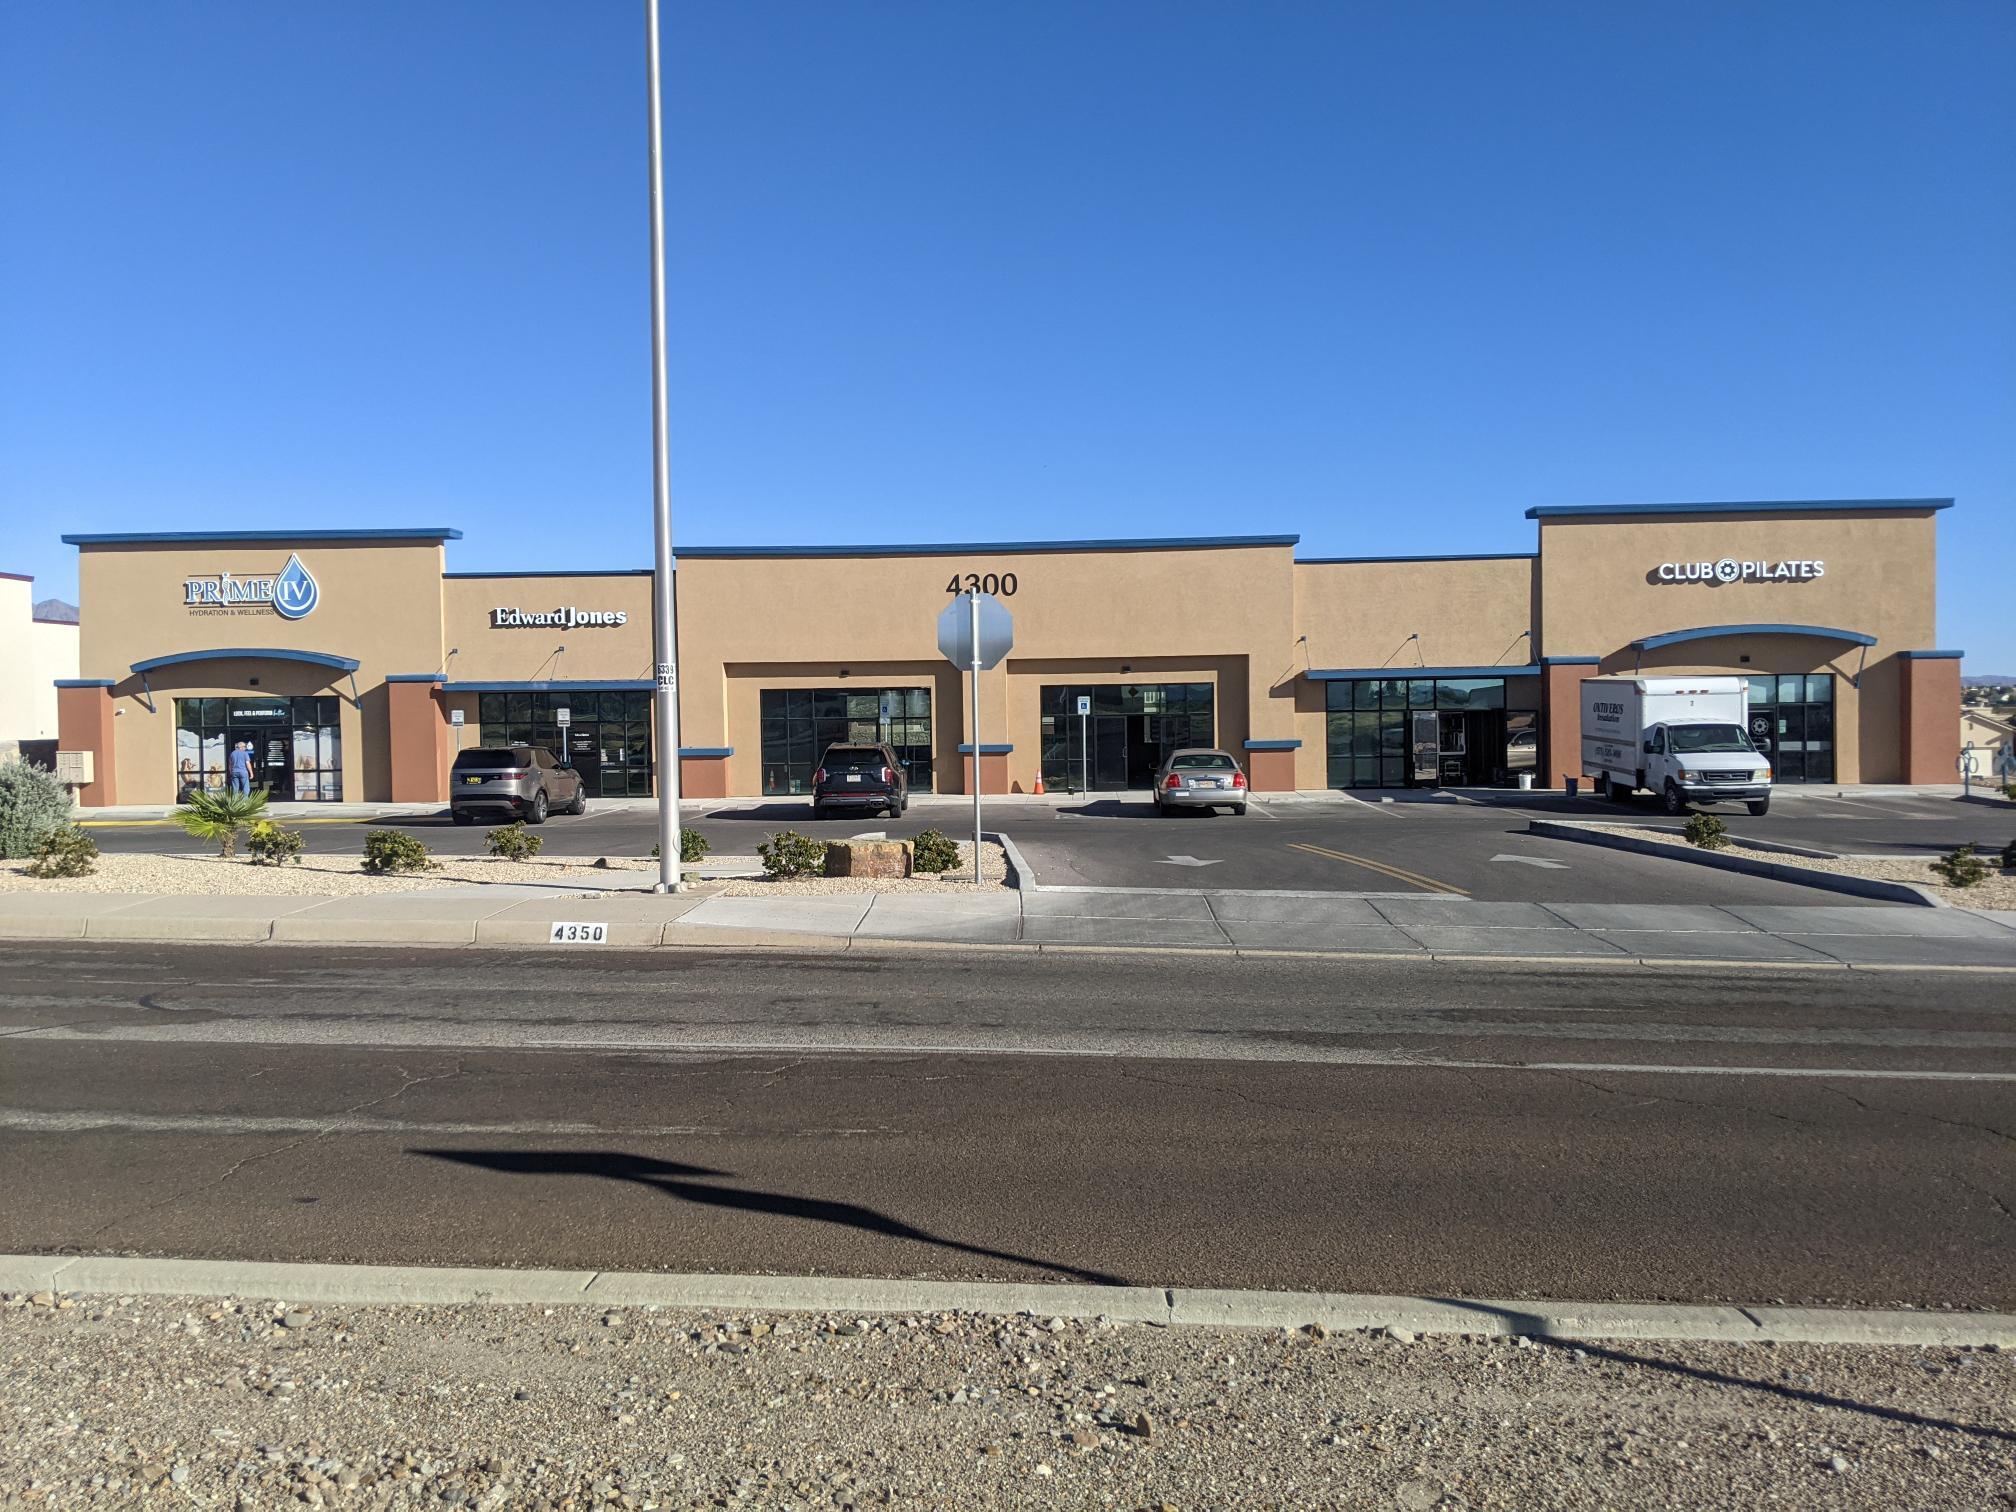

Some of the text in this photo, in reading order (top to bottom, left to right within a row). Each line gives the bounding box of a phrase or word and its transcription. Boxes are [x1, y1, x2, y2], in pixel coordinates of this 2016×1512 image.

[1658, 559, 1825, 580] CLUB PILATES
[282, 580, 310, 601] IV
[945, 572, 1018, 597] 4300
[189, 609, 229, 617] HYDRATION
[238, 608, 275, 616] WELLNESS
[657, 675, 674, 686] CLC
[554, 925, 603, 941] 4350
